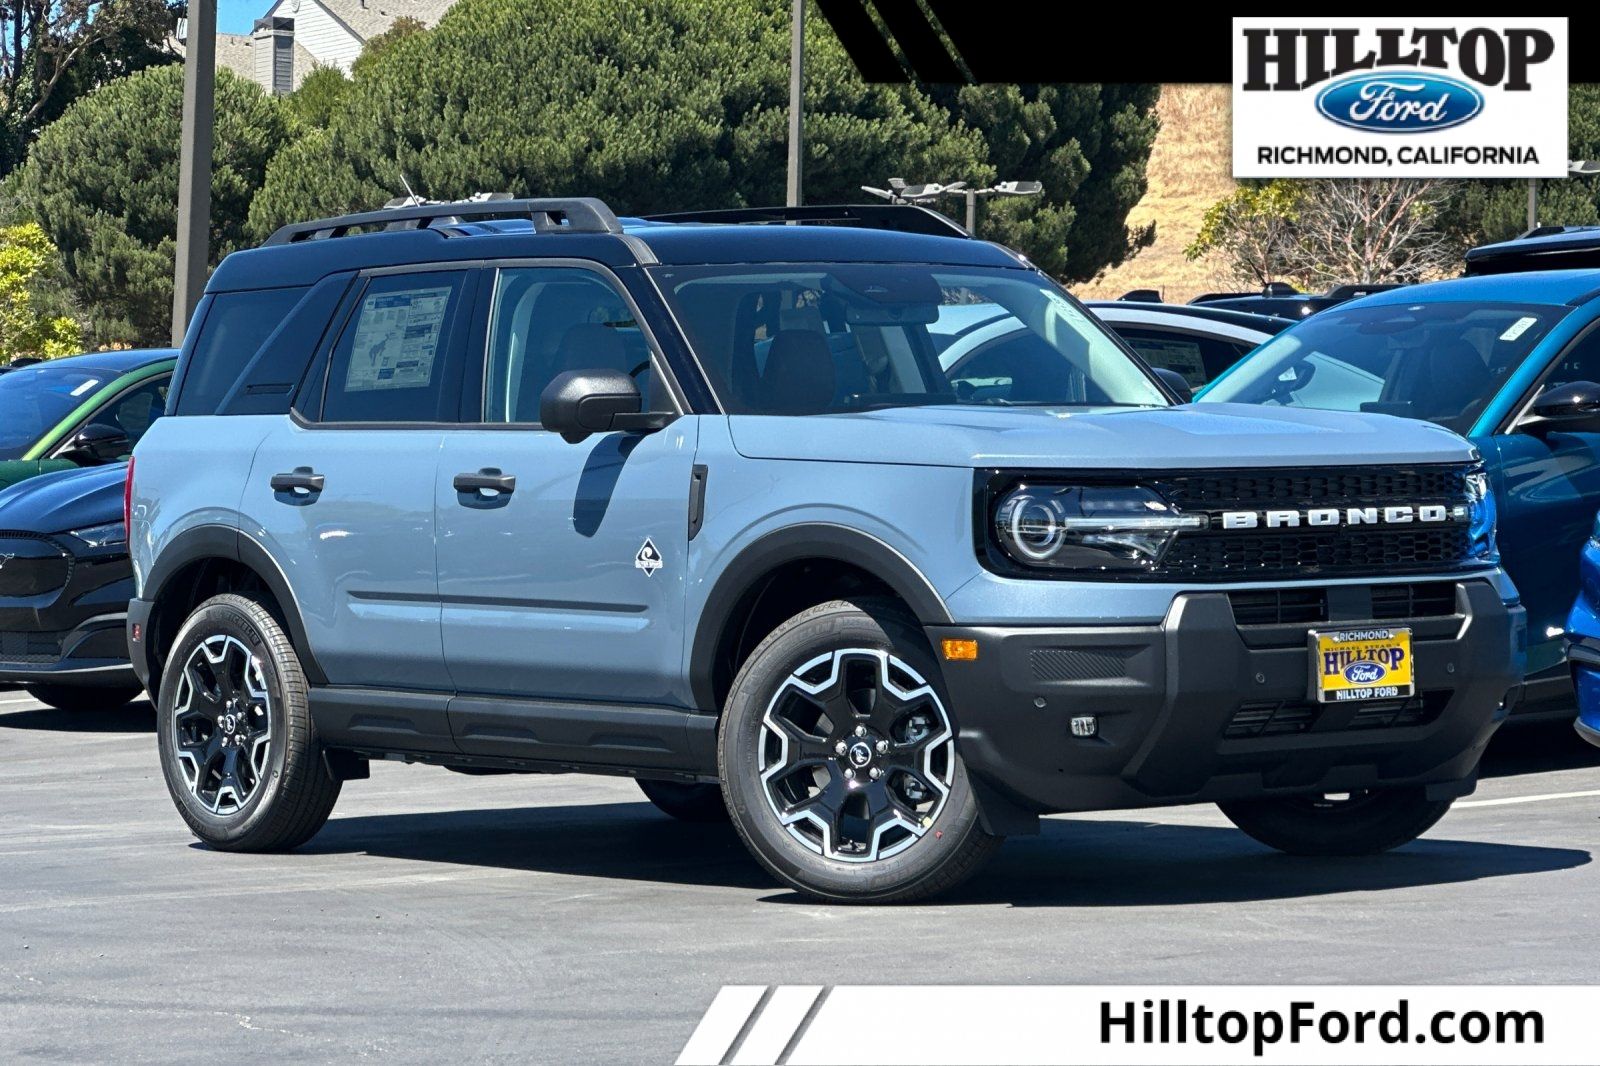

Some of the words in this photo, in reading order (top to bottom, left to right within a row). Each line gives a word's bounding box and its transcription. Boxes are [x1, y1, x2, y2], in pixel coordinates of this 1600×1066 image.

[1222, 505, 1446, 529] BRONCO
[1339, 631, 1388, 641] RICHMOND
[1324, 648, 1404, 675] HILLTOP
[1352, 665, 1378, 681] Ford
[1337, 688, 1373, 699] HILLTOP
[1374, 687, 1398, 697] FORD
